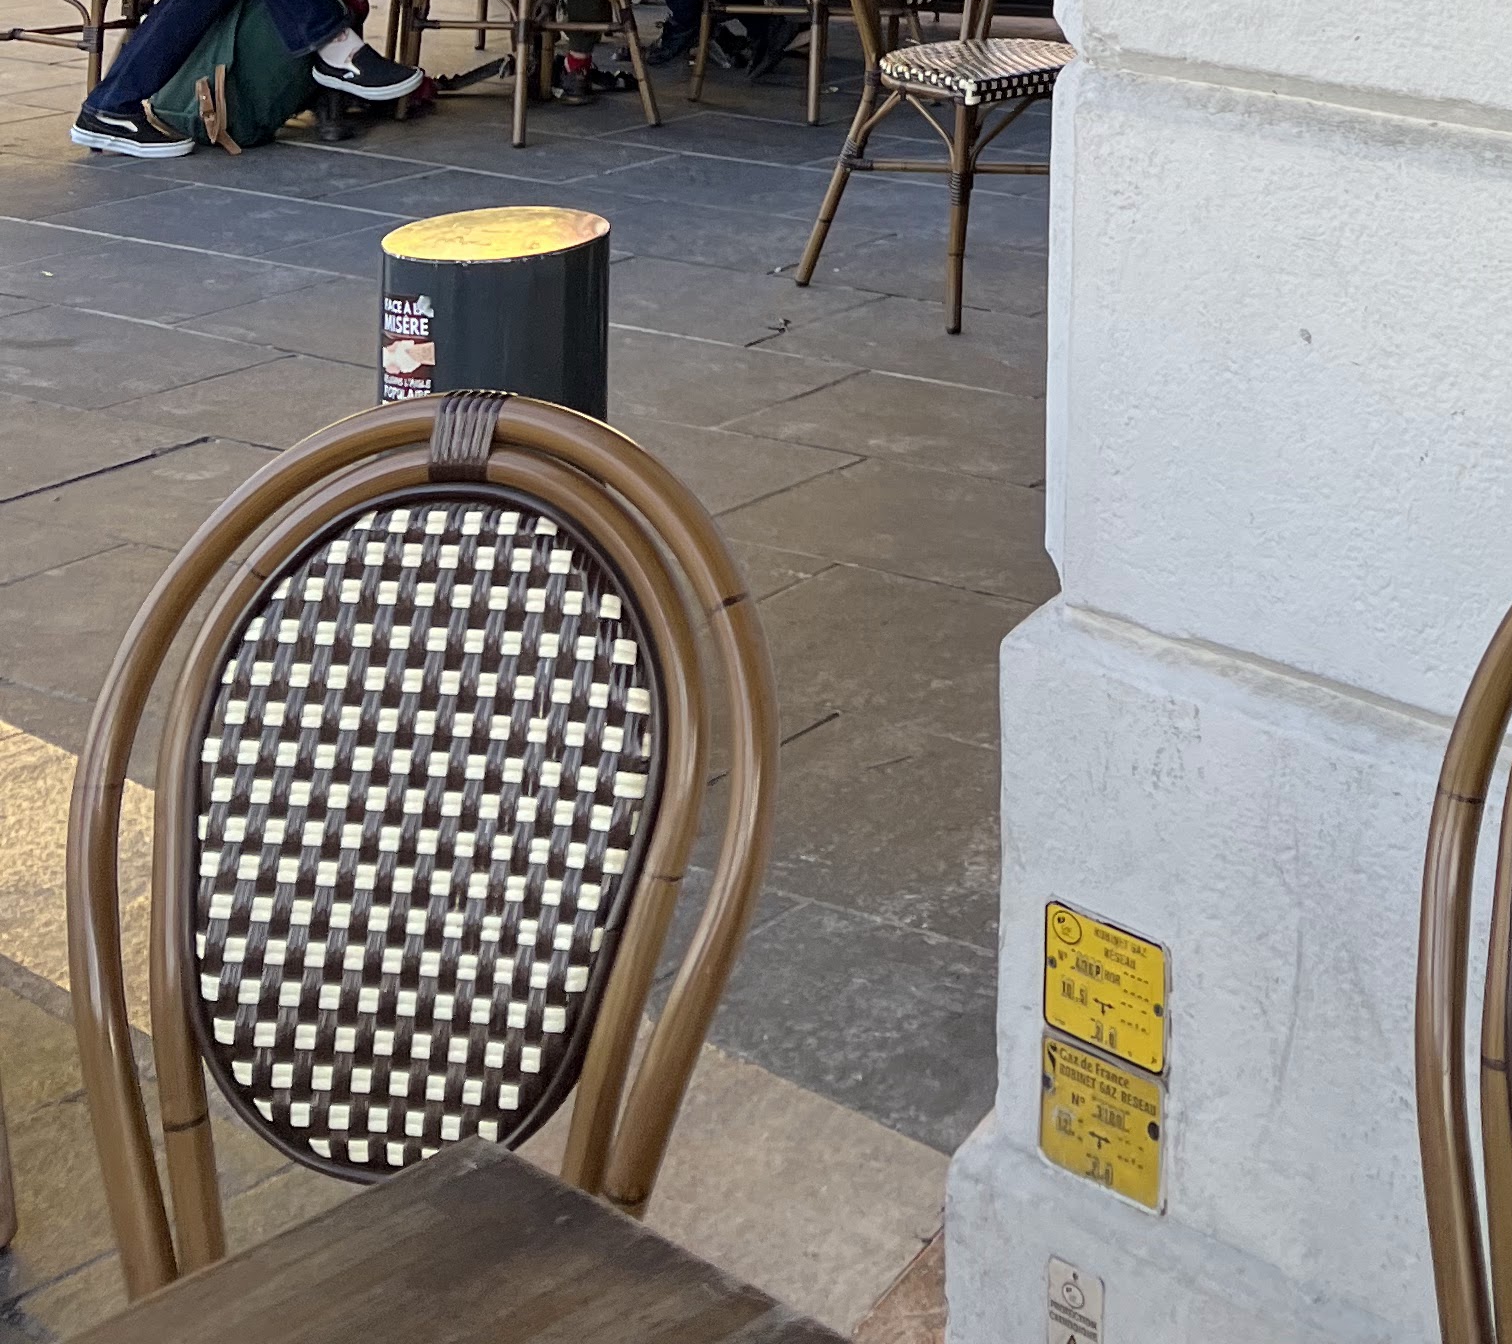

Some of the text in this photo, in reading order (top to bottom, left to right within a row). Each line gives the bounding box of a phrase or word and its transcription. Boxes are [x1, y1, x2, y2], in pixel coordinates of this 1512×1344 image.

[385, 298, 402, 314] FACE
[385, 313, 430, 336] MISÈRE
[1132, 945, 1148, 958] GAZ
[1061, 1048, 1129, 1089] Gaz de France
[1060, 1064, 1096, 1089] ROBINET
[1100, 1082, 1117, 1099] GAZ
